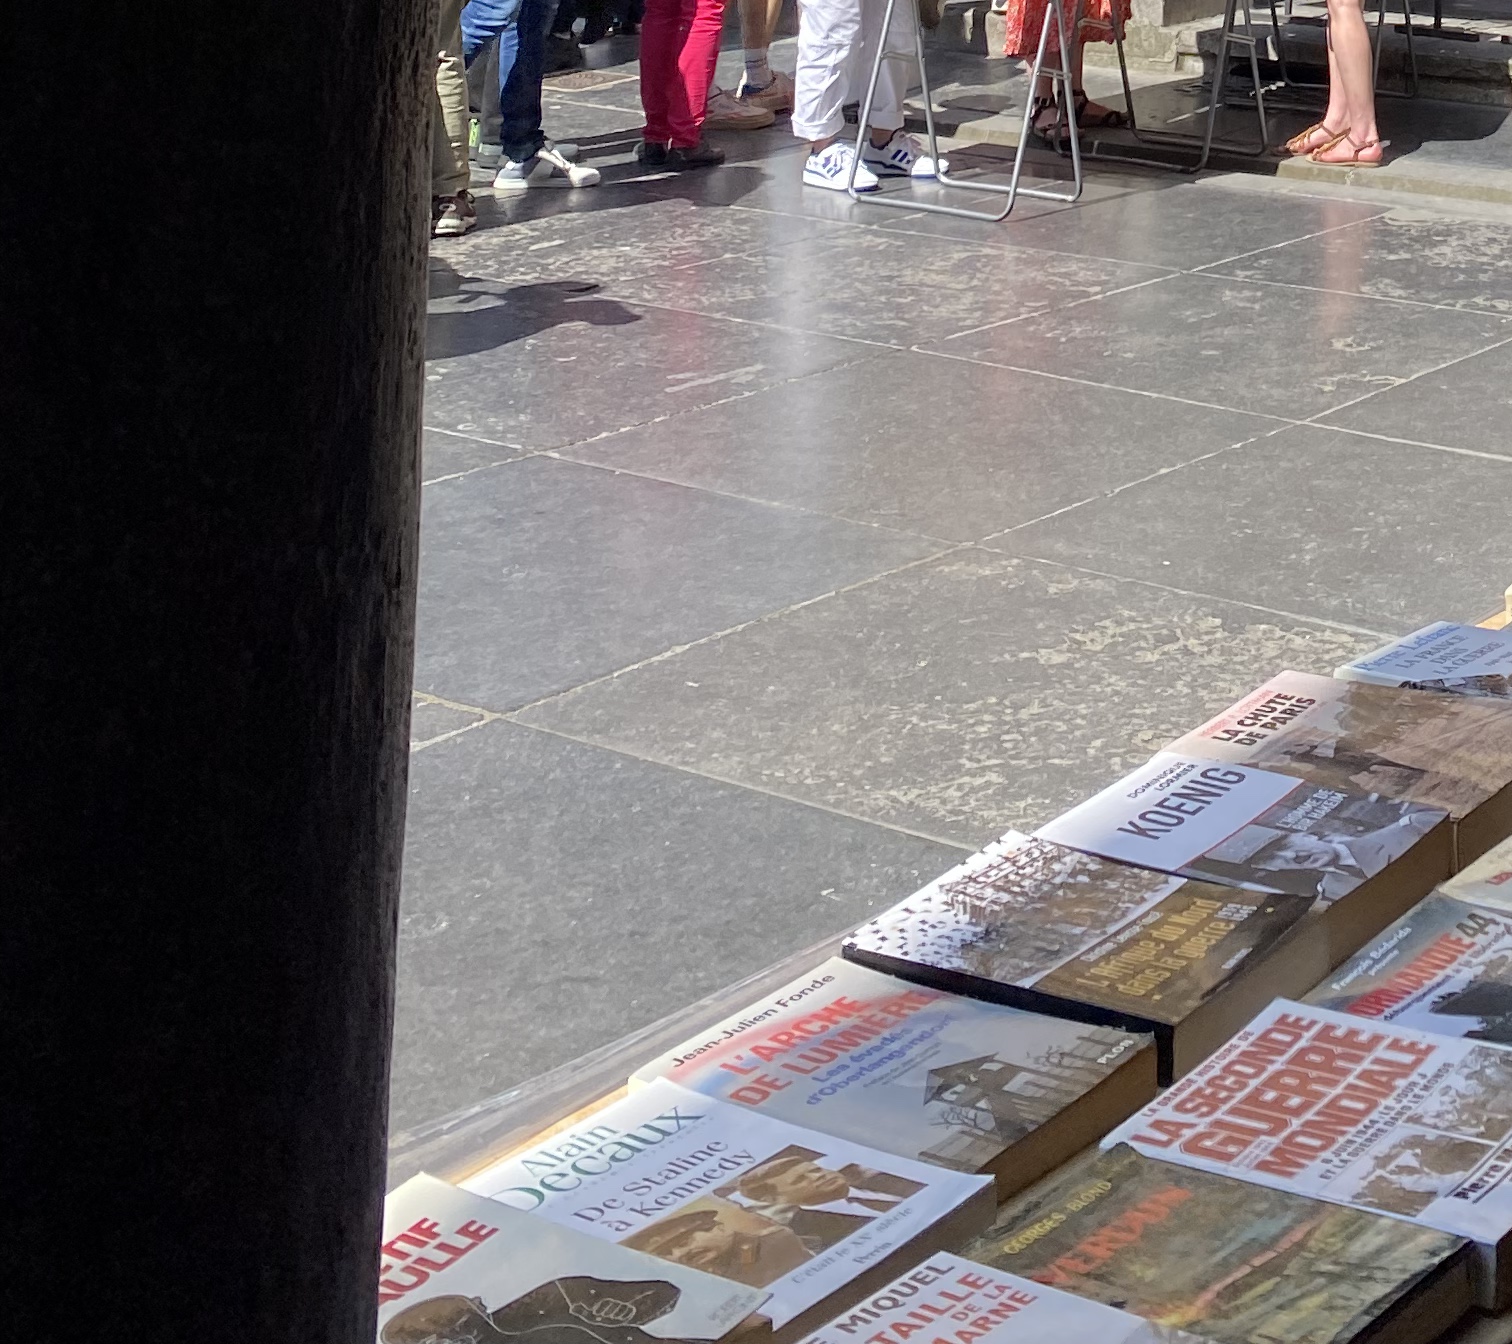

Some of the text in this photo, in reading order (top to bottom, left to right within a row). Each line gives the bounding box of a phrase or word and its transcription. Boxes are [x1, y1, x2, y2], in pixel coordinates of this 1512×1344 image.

[1395, 658, 1417, 670] LA
[1412, 634, 1470, 660] FRANCE
[1430, 646, 1470, 666] DANS
[1211, 692, 1297, 742] LA CHUTE
[1233, 696, 1317, 747] DE PARIS
[1115, 767, 1247, 841] KOENIG
[1076, 939, 1166, 987] L'Afrique
[1150, 924, 1188, 941] du
[1115, 968, 1172, 997] dans
[1152, 956, 1189, 971] la
[1172, 921, 1236, 959] guerre
[1455, 912, 1501, 939] 44
[672, 973, 837, 1069] Jean-Julien Fonde
[719, 995, 868, 1076] L'ARCHE
[728, 1072, 794, 1106] DE
[781, 988, 946, 1077] LUMIÈRE
[1096, 1039, 1135, 1065] PLON
[811, 1062, 849, 1084] Les
[1129, 1012, 1319, 1149] LA SECONDE
[1177, 1022, 1388, 1164] GUERRE
[1251, 1036, 1440, 1180] MONDIALE
[488, 1106, 707, 1213] Decaux
[520, 1122, 622, 1178] Alain
[571, 1198, 625, 1223] De
[621, 1139, 729, 1197] Staline
[601, 1216, 635, 1234] à
[628, 1148, 758, 1219] Kennedy
[1003, 1179, 1113, 1256] GEORGES BLOND
[1030, 1184, 1195, 1285] VERDUN
[834, 1262, 956, 1335] MIQUEL
[951, 1281, 1013, 1323] DE LA
